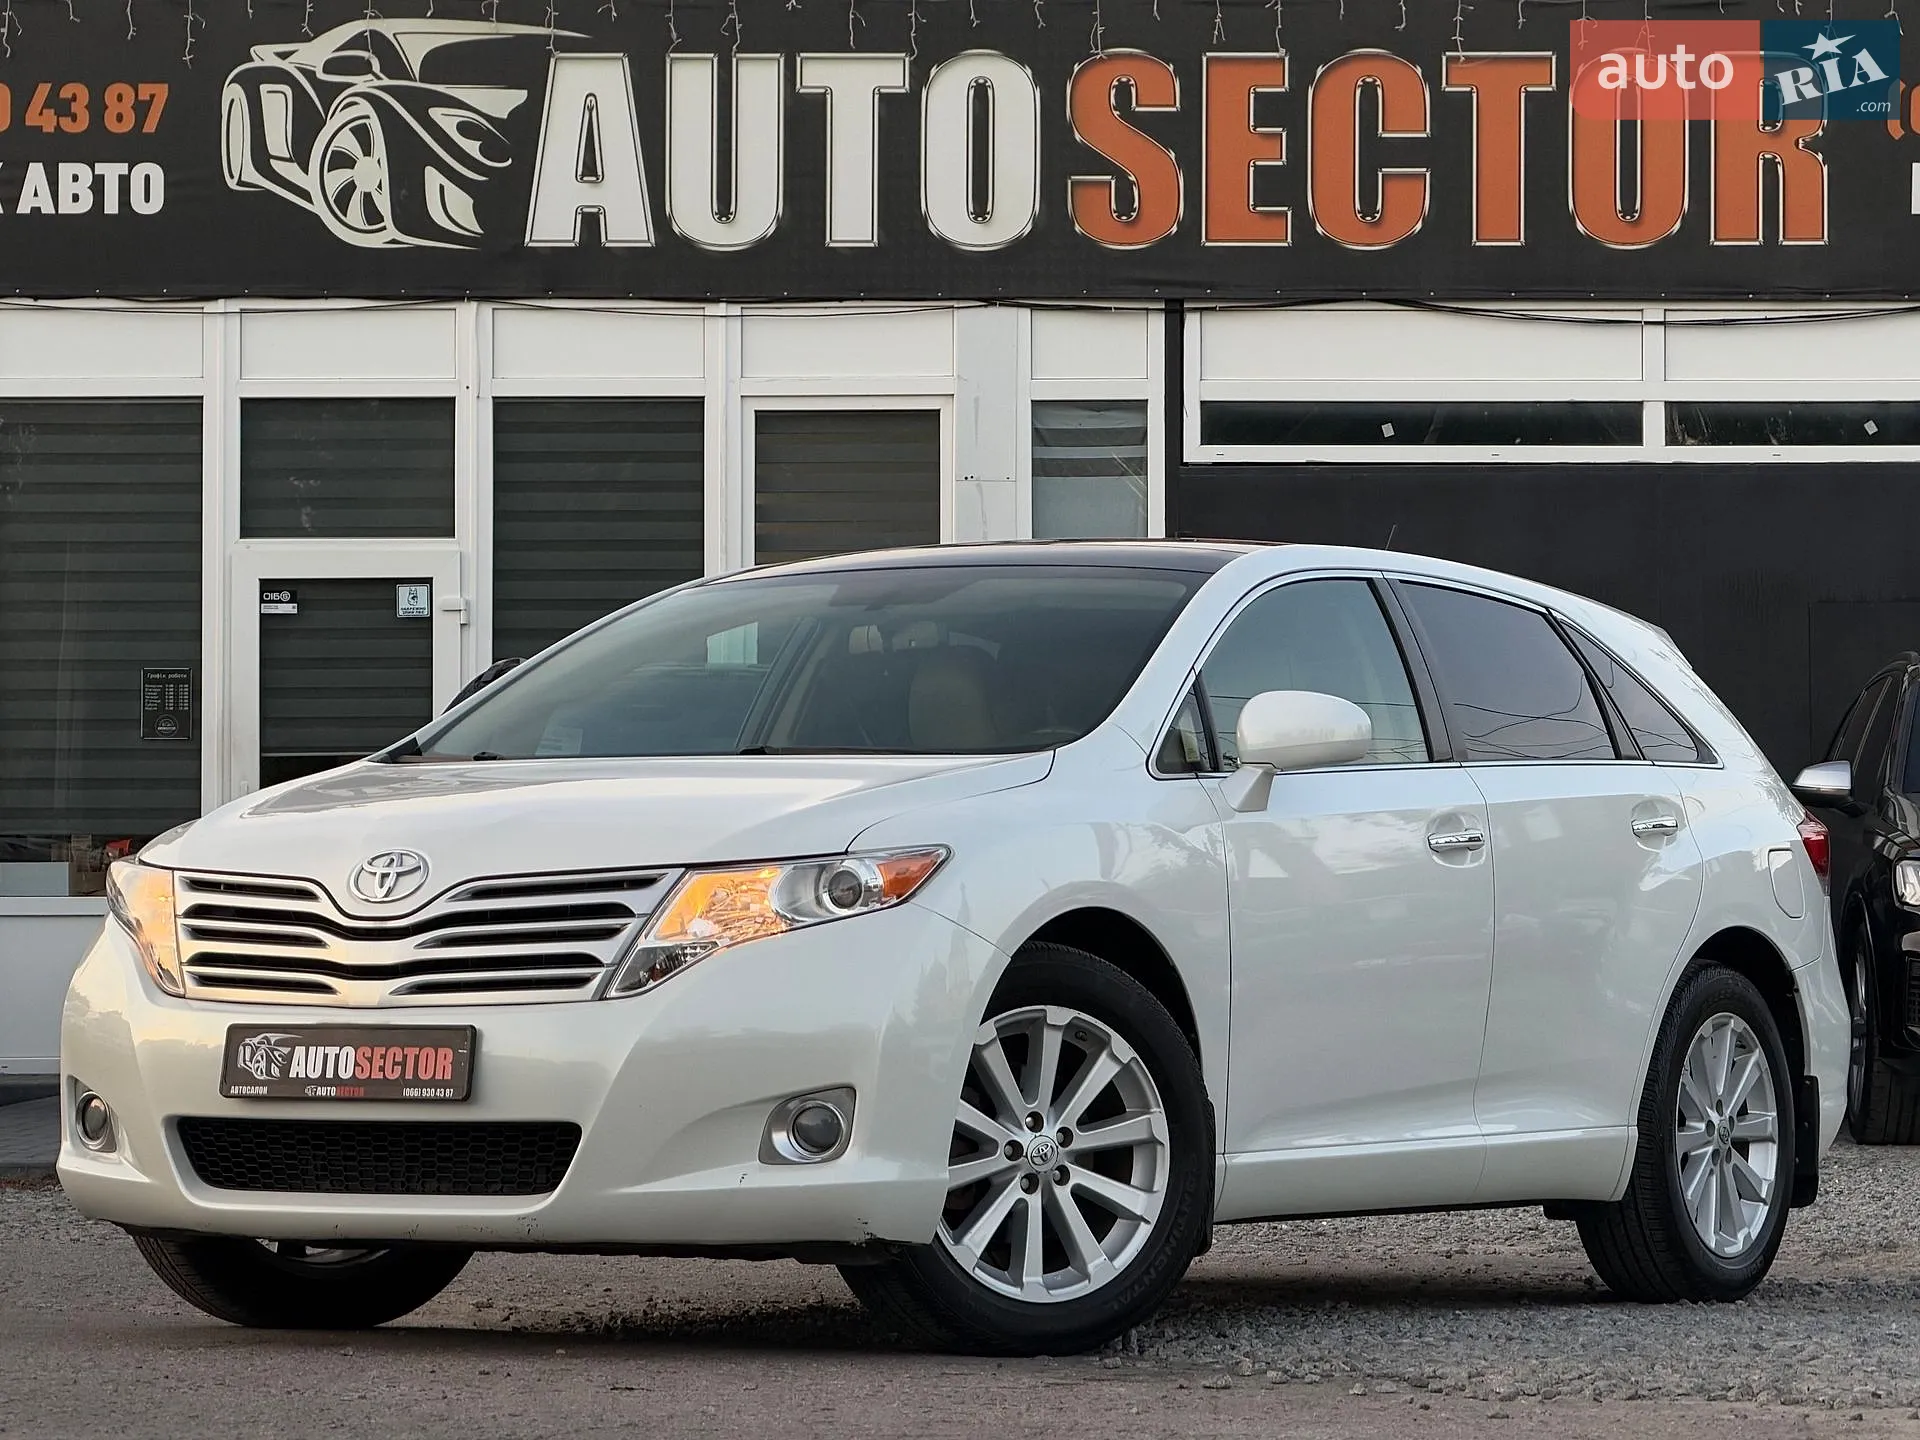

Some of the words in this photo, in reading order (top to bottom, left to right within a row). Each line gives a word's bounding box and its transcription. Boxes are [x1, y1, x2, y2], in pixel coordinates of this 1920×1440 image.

[25, 82, 90, 134] 43
[103, 82, 169, 134] 87
[524, 47, 1829, 252] AUTOSECTOR
[16, 162, 165, 215] АВТО
[288, 1046, 454, 1081] AUTOSECTOR
[422, 1087, 435, 1097] 930
[436, 1088, 445, 1097] 43
[445, 1088, 454, 1098] 87
